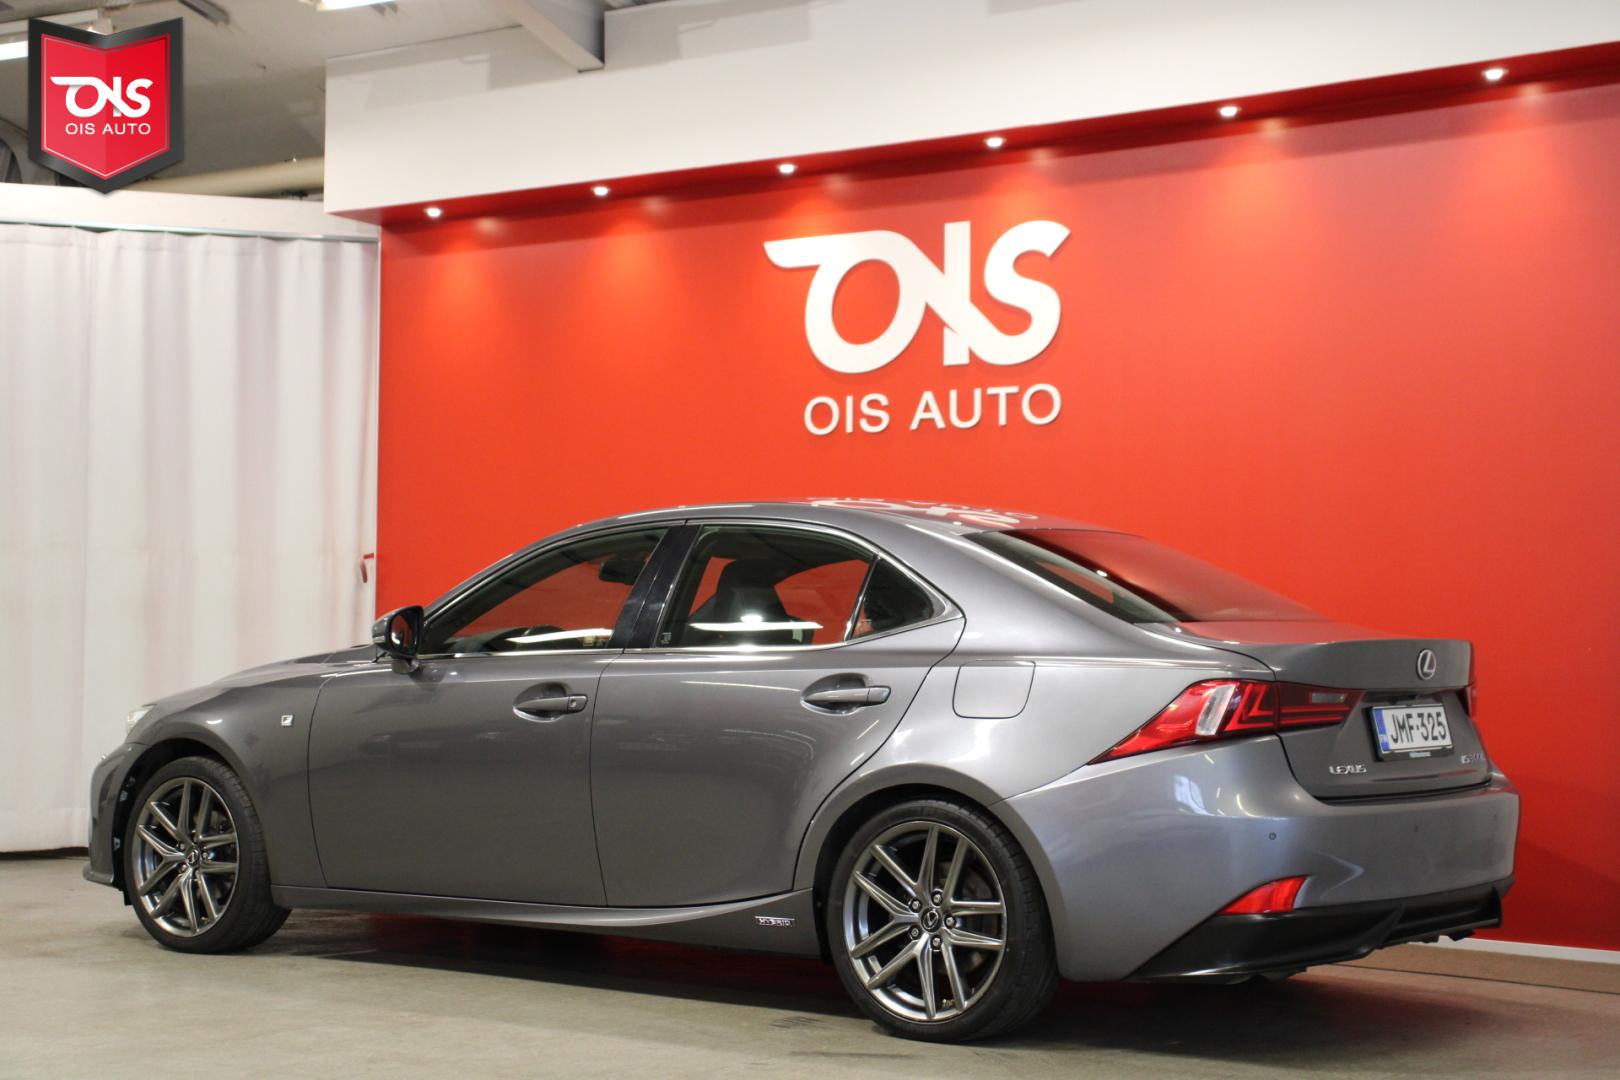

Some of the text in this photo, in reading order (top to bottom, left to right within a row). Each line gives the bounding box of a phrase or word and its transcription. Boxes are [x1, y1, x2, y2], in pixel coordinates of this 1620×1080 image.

[763, 220, 1071, 374] OIS
[804, 383, 1062, 435] OIS AUTO
[1390, 711, 1447, 744] JMF-325
[1329, 764, 1367, 775] LEXUS
